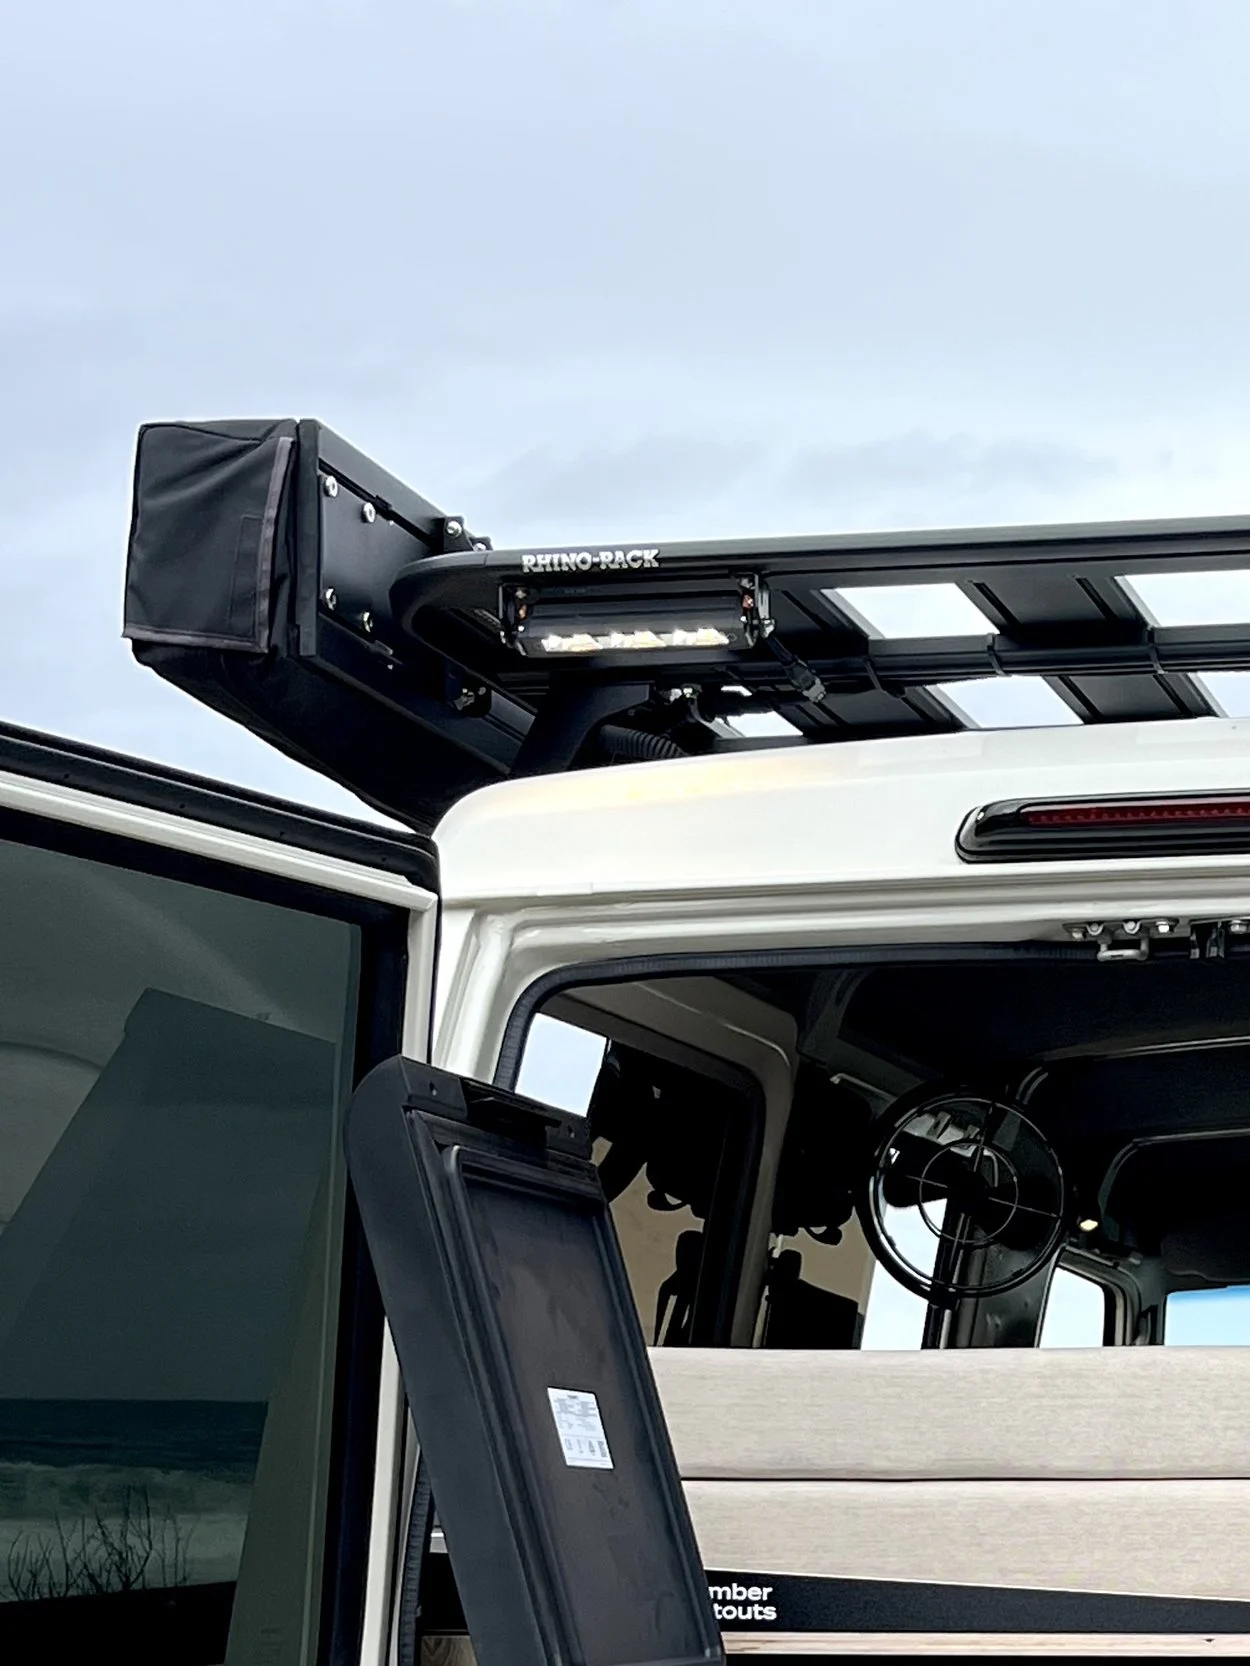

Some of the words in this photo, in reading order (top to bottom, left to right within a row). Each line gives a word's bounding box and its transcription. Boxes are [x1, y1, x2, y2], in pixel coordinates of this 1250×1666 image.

[521, 548, 660, 574] RHINO-RACK
[708, 1582, 773, 1601] mber
[713, 1602, 777, 1620] touts
